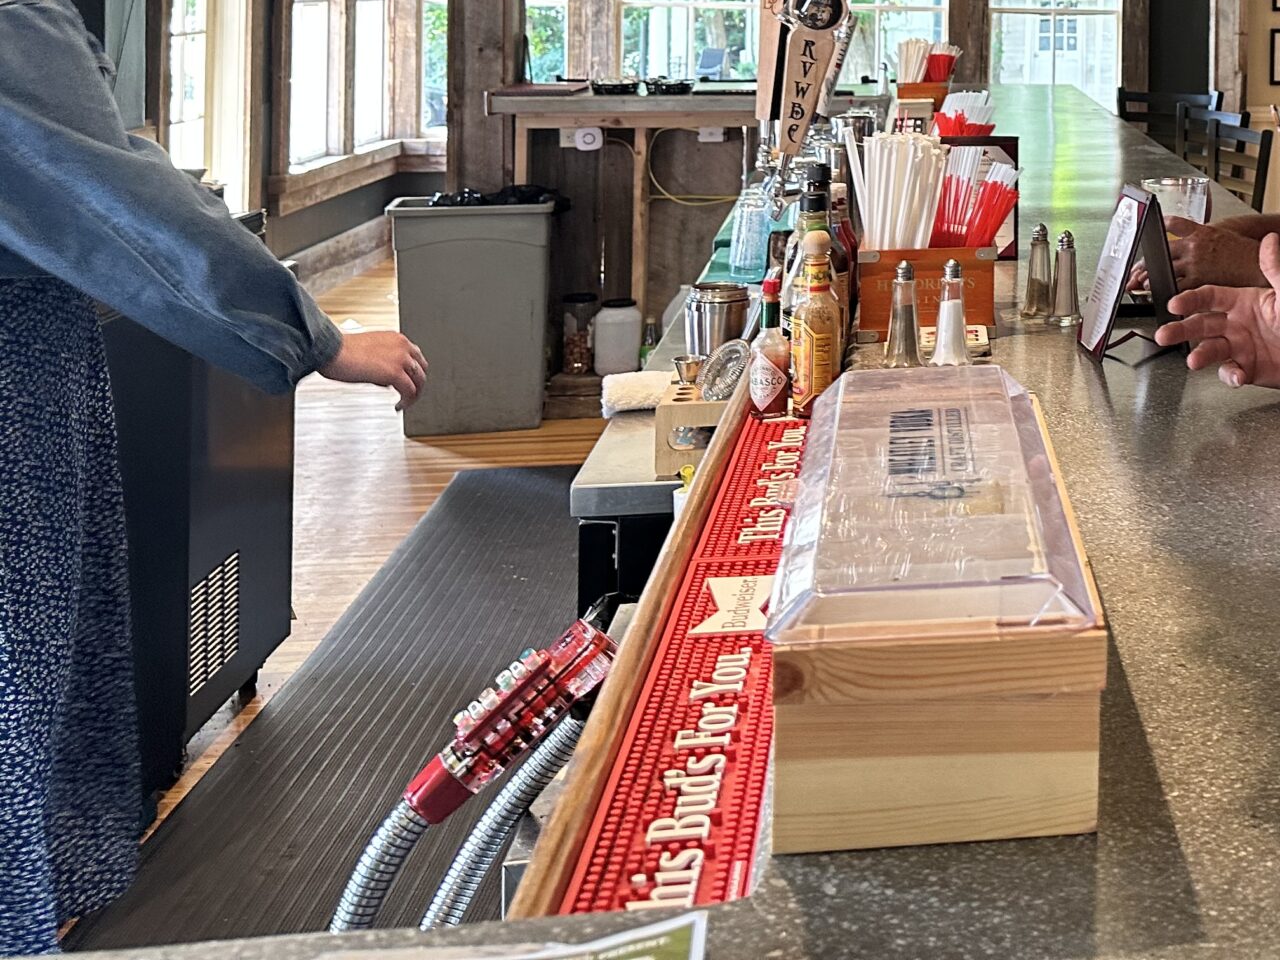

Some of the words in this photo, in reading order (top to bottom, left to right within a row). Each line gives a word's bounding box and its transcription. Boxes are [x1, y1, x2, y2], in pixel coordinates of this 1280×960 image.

[917, 295, 941, 304] IN
[889, 409, 934, 433] VODKA
[944, 407, 965, 444] DISTILLED
[761, 449, 801, 472] For
[948, 446, 968, 472] CRAFT
[737, 507, 786, 545] This
[688, 646, 752, 702] You.
[674, 701, 740, 751] For
[645, 753, 727, 844] Bud's
[626, 847, 705, 912] his
